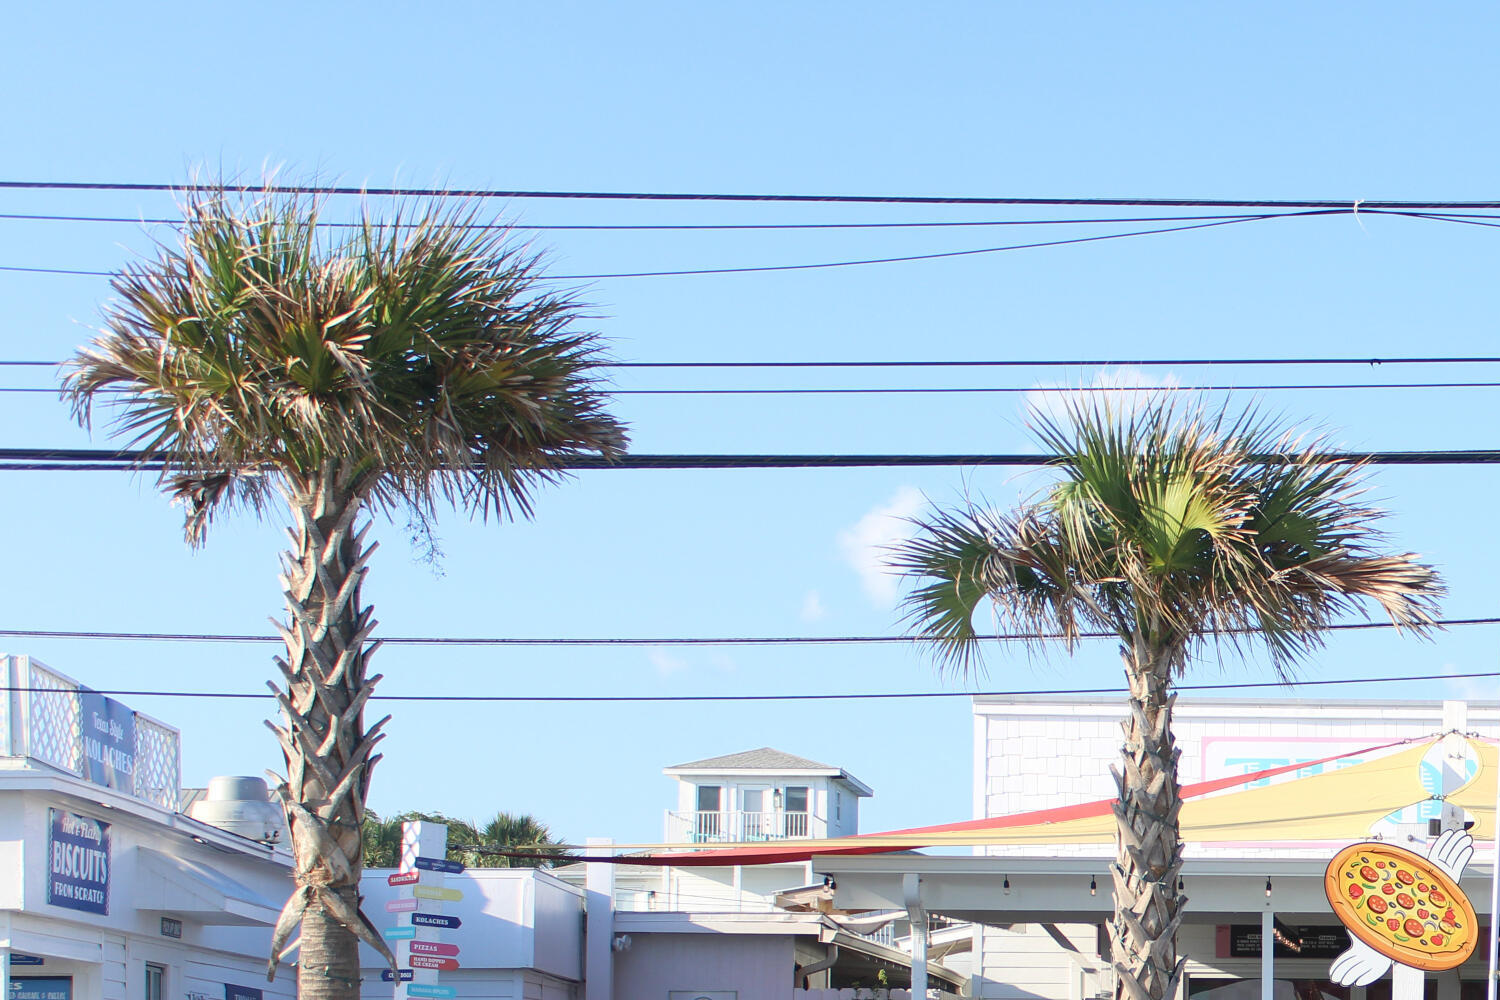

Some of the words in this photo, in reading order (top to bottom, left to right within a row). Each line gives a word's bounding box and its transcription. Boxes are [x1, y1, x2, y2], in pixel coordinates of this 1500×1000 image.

[84, 735, 133, 775] KOLACHES
[53, 840, 107, 884] BISCUITS
[54, 881, 74, 899] FROM
[74, 884, 105, 905] SCRATCH
[415, 916, 449, 926] KOLACHES
[413, 944, 438, 952] PIZZAS
